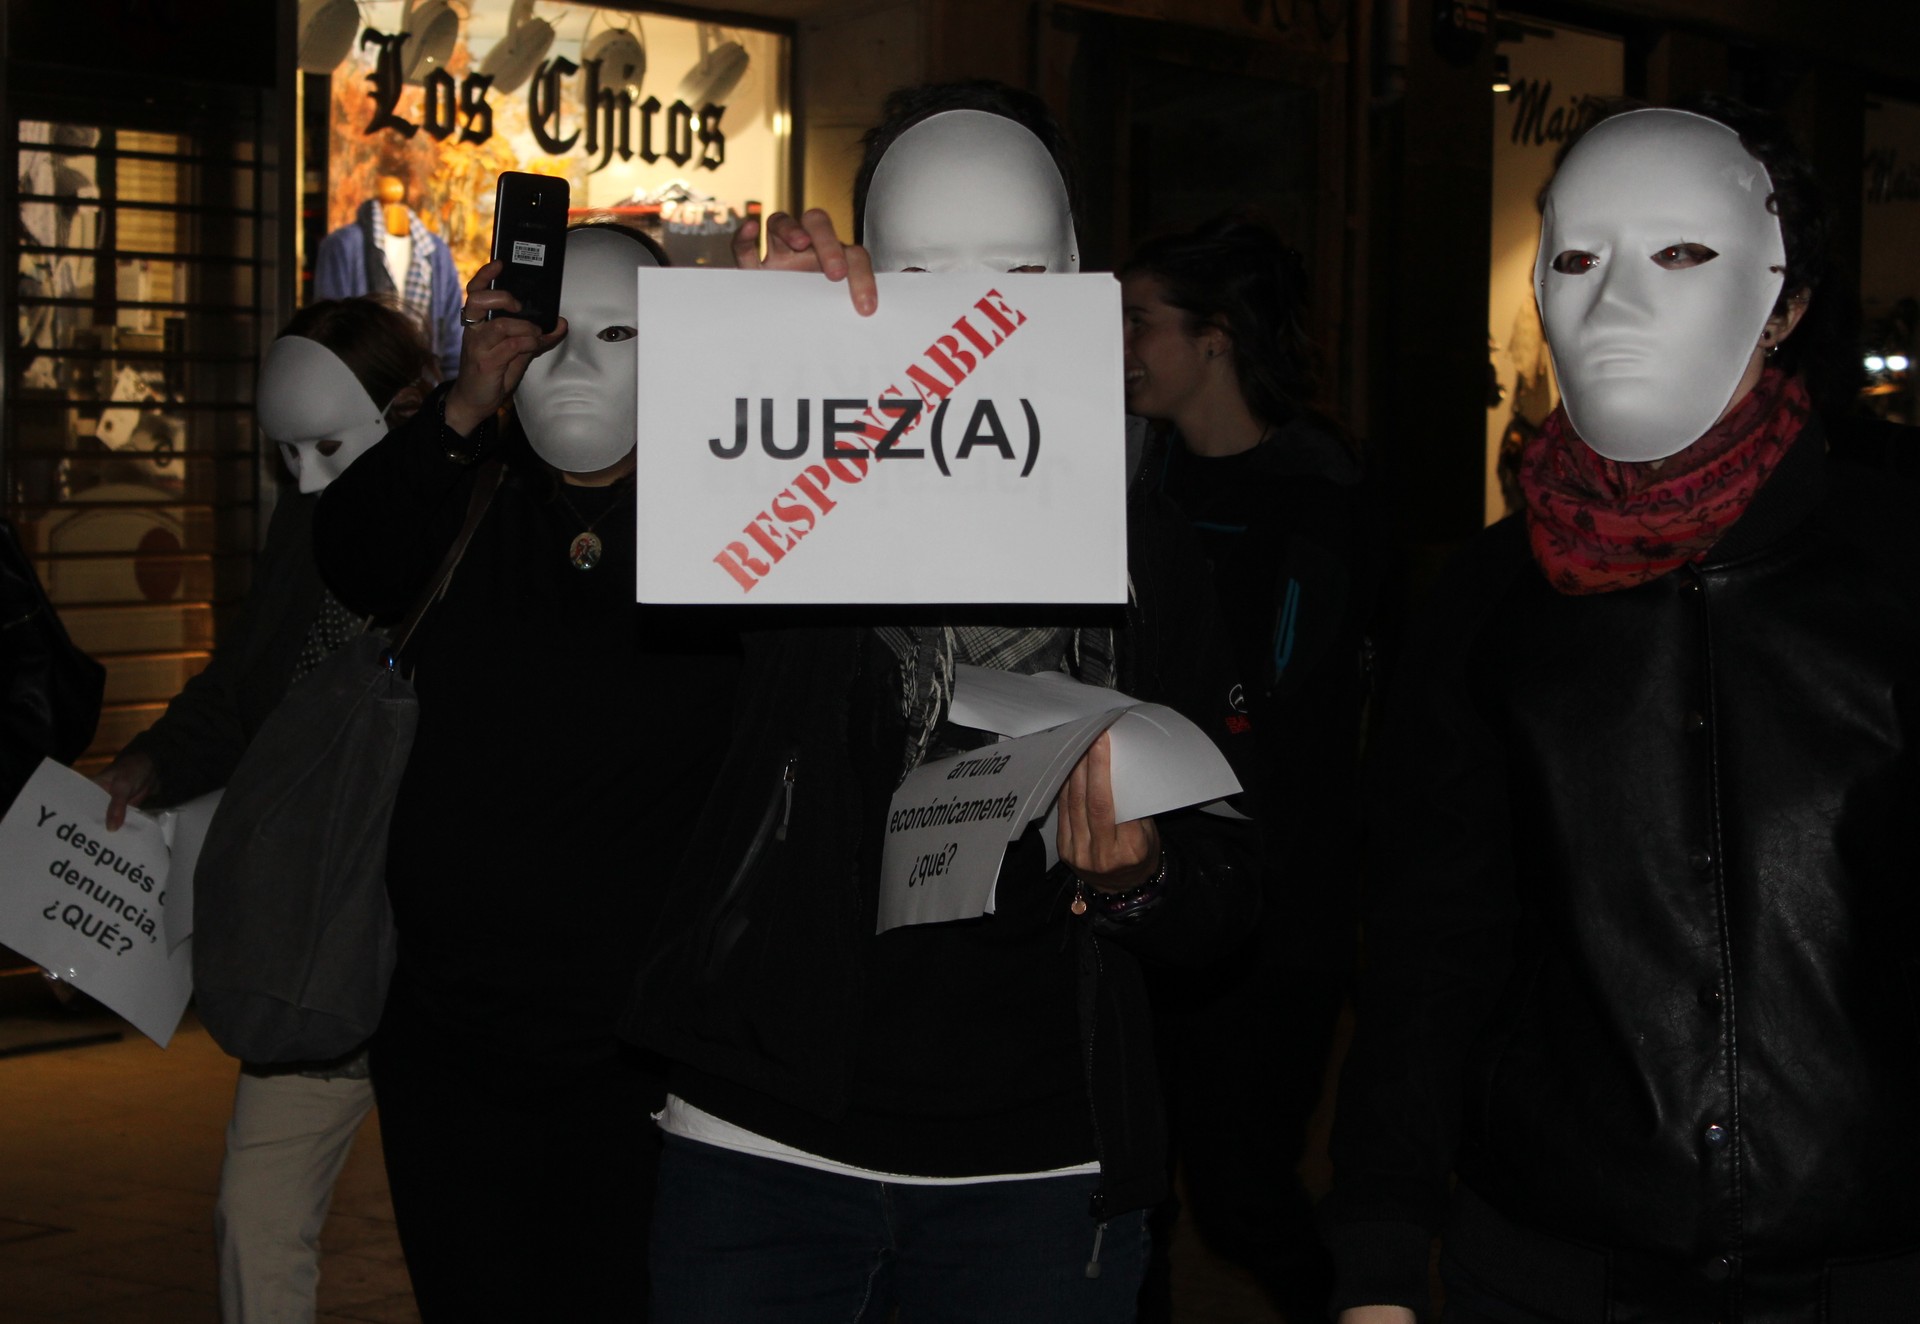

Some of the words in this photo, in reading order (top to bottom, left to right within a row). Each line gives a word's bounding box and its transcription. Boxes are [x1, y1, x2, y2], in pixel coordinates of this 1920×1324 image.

[361, 27, 494, 146] Los
[529, 56, 727, 176] Chicos
[708, 397, 1041, 478] JUEZ(A)
[712, 288, 1027, 593] RESPONSABLE
[36, 804, 56, 828] Y
[55, 822, 155, 893] después
[889, 790, 1018, 834] económicamente,
[49, 859, 158, 944] denuncia,
[908, 843, 958, 888] ¿qué?
[42, 899, 133, 956] ¿QUÉ?
